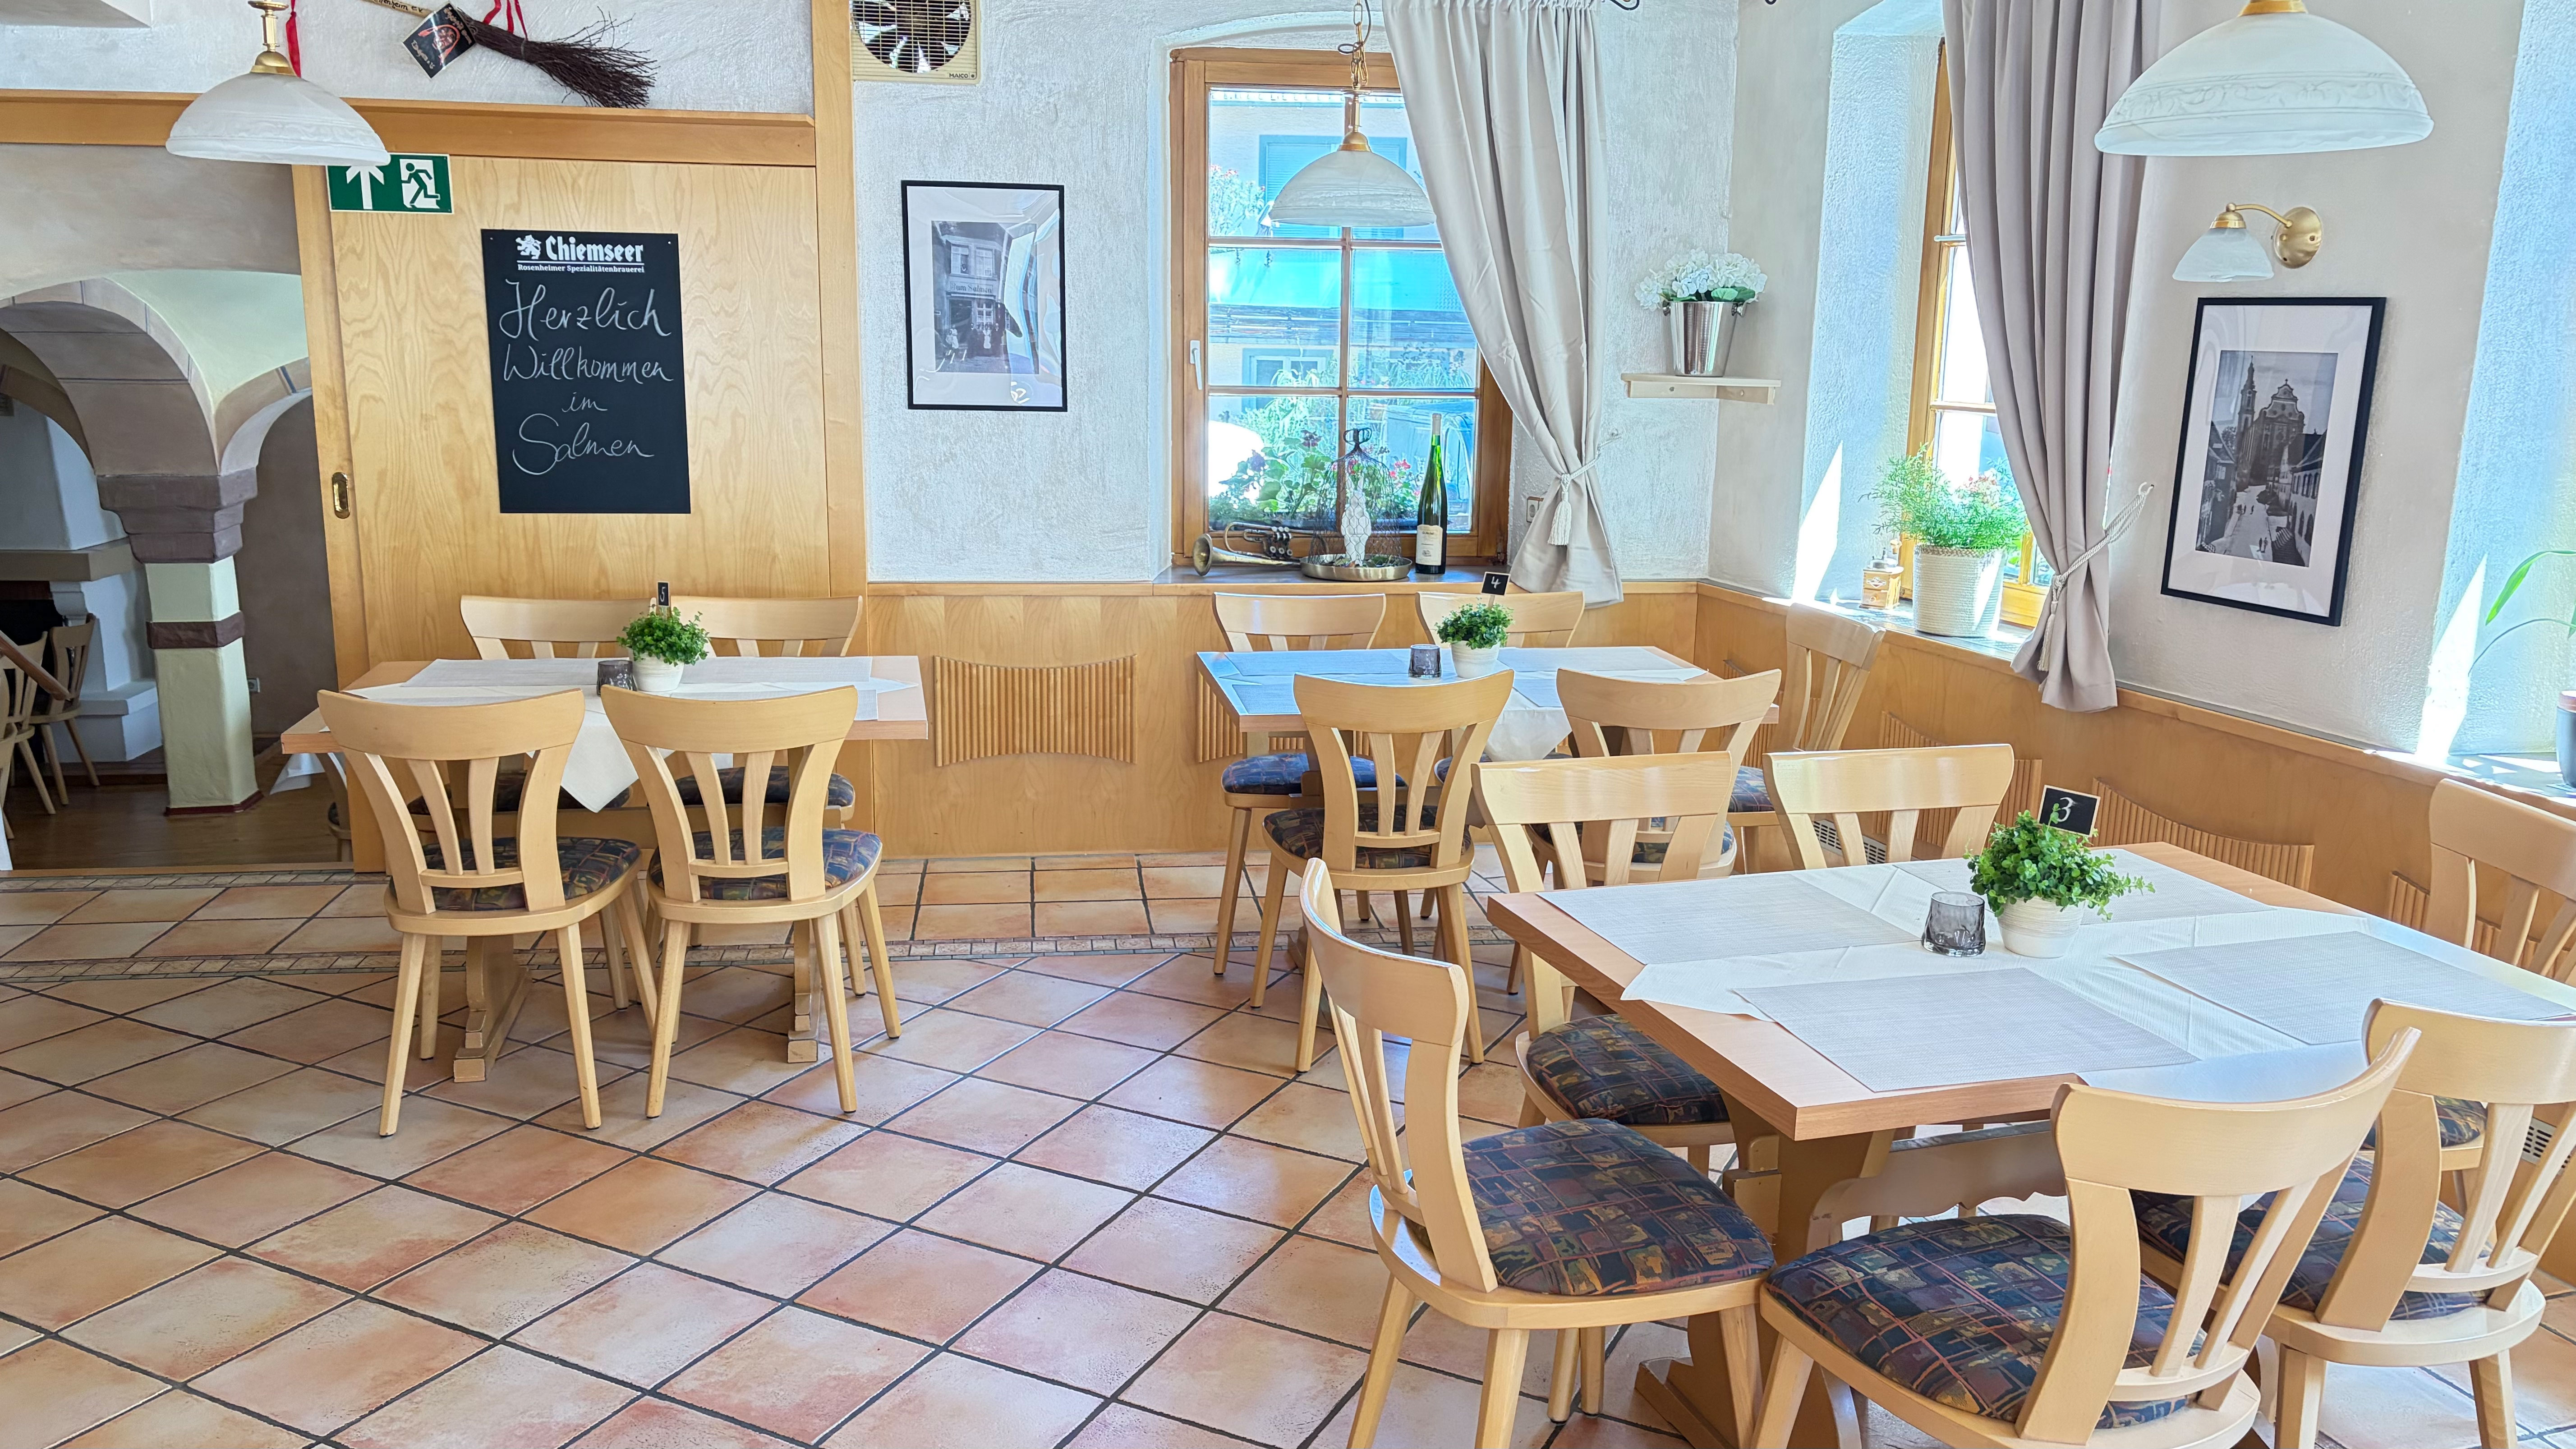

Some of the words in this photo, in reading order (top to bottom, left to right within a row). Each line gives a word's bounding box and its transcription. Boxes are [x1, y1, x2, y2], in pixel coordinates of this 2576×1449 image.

[545, 235, 644, 262] Chiemseer
[566, 265, 645, 273] Spezialitätenbrauerei
[499, 278, 672, 341] Herzlich
[503, 343, 674, 384] Willkommen
[561, 391, 608, 413] im
[512, 413, 655, 475] Salmen
[660, 586, 666, 603] 5
[1490, 575, 1501, 589] 4
[2057, 796, 2078, 822] 3
